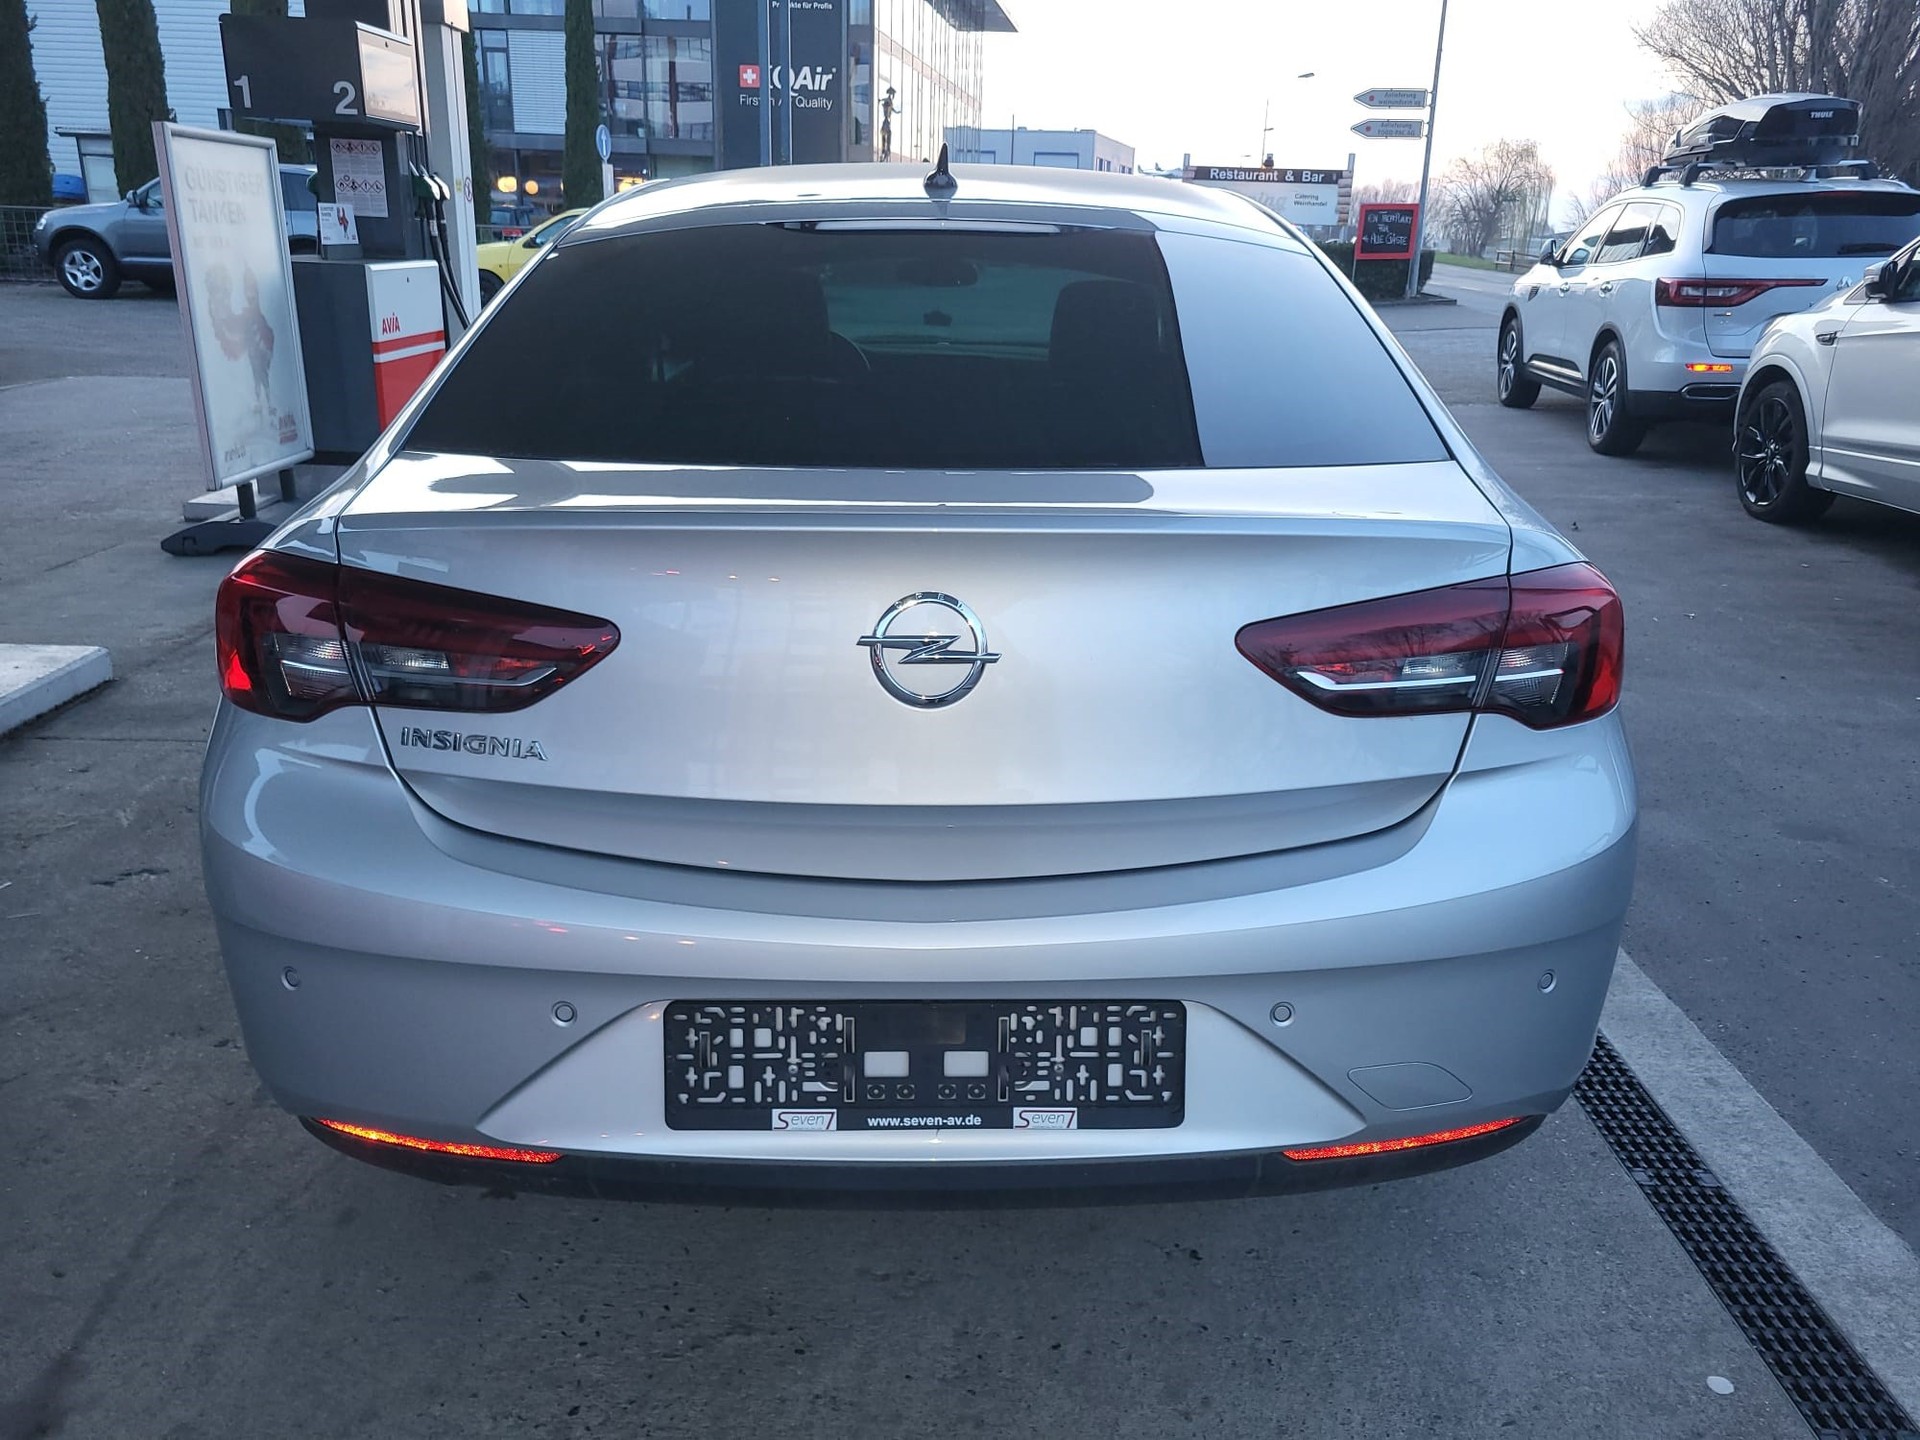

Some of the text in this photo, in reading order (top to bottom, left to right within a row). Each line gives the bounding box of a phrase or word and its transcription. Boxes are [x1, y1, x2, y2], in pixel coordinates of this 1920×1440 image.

[802, 2, 813, 10] für
[813, 2, 833, 10] Profis
[234, 75, 252, 109] 1
[333, 81, 358, 115] 2
[795, 96, 833, 111] Quality
[1810, 110, 1834, 118] THULE
[1210, 168, 1325, 182] Restaurant & Bar
[1294, 193, 1319, 201] Catering
[401, 727, 549, 761] INSIGNIA
[867, 1114, 982, 1127] www.seven-av.de
